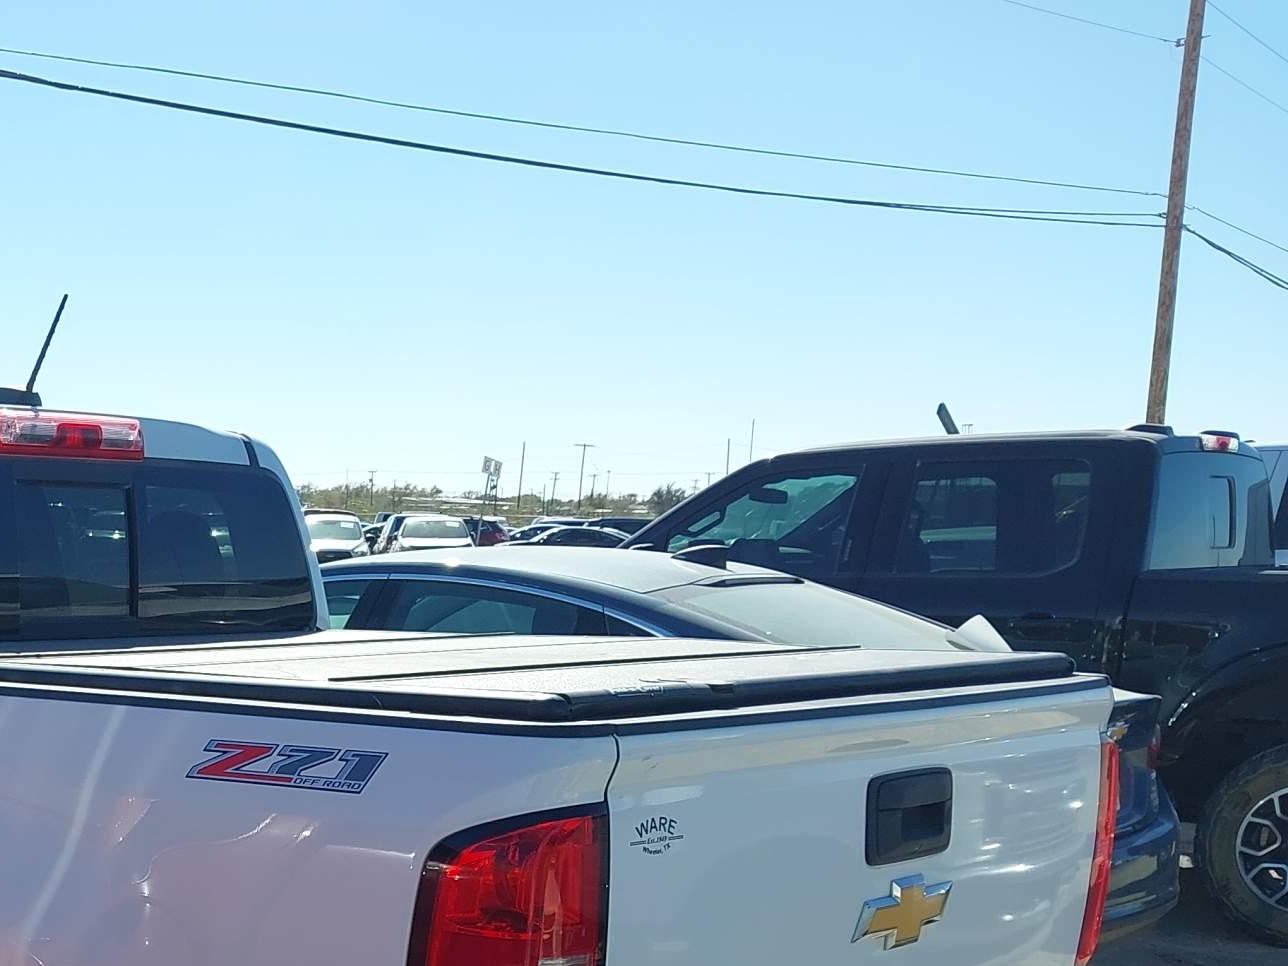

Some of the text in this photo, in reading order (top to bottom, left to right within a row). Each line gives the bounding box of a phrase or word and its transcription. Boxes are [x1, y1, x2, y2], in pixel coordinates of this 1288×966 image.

[185, 739, 389, 794] Z71
[292, 777, 363, 791] OFF ROAD
[635, 816, 678, 838] WARE
